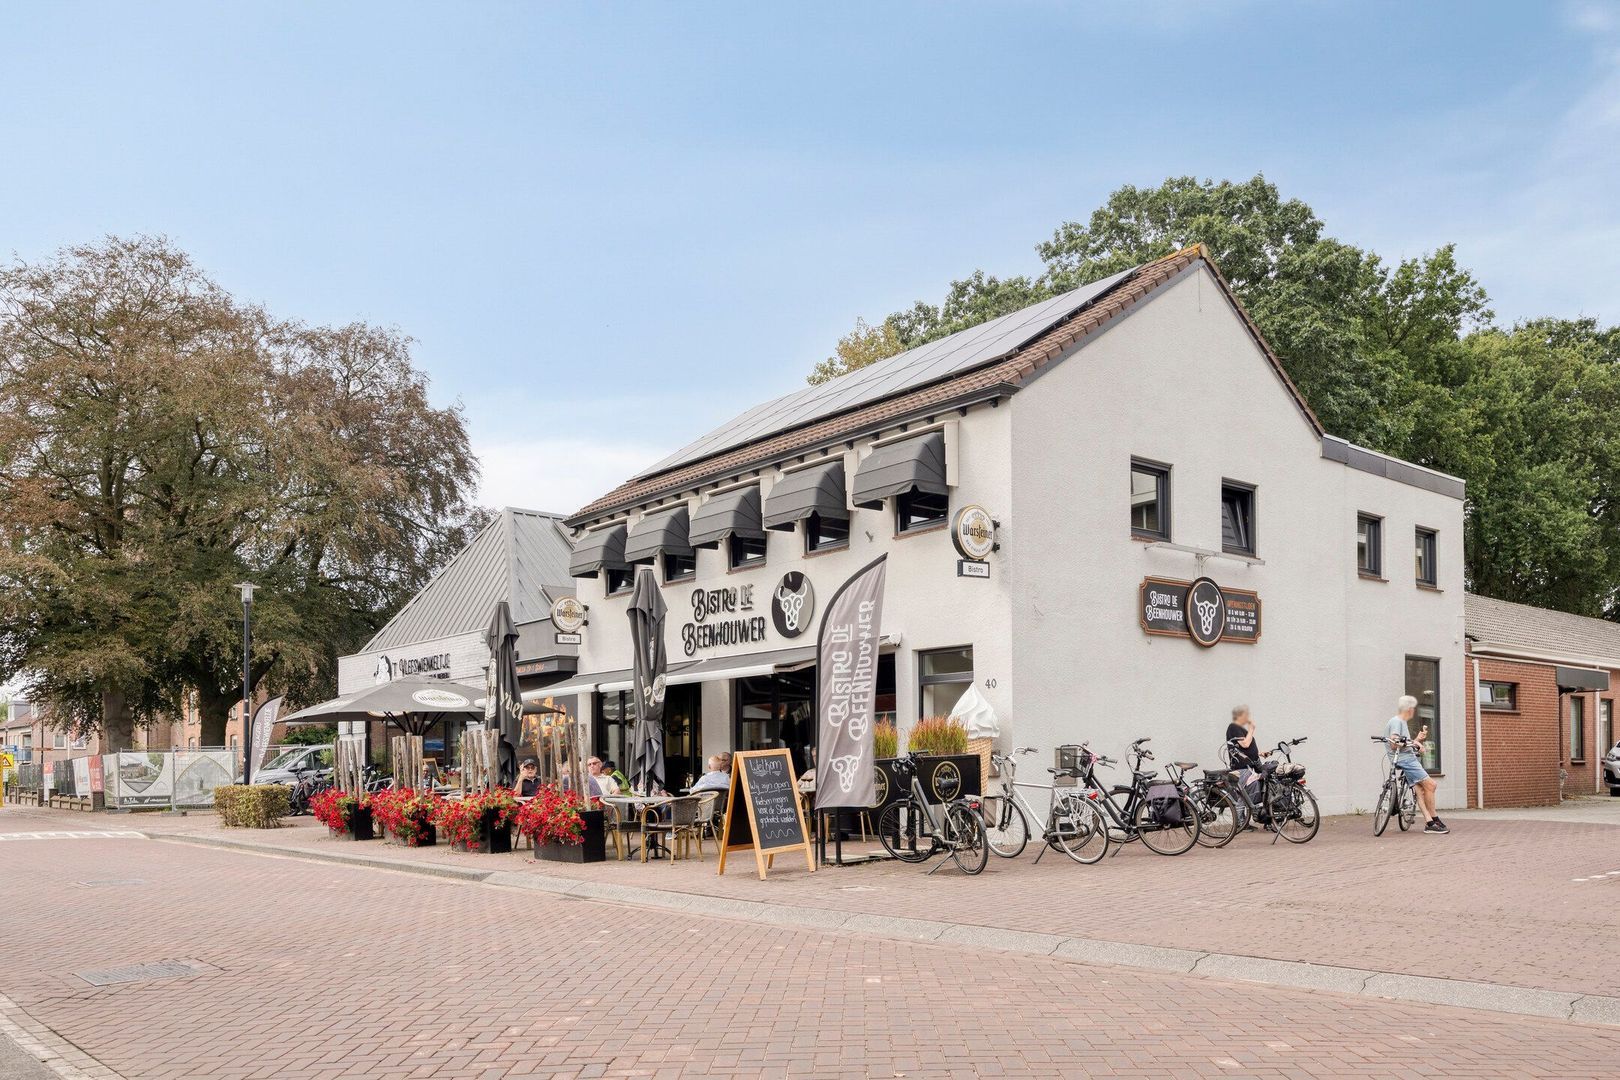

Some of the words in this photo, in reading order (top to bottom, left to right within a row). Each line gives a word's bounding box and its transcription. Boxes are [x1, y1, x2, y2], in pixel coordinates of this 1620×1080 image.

[962, 523, 992, 540] Warsteiner
[968, 565, 983, 574] Bistro
[985, 678, 997, 689] 40
